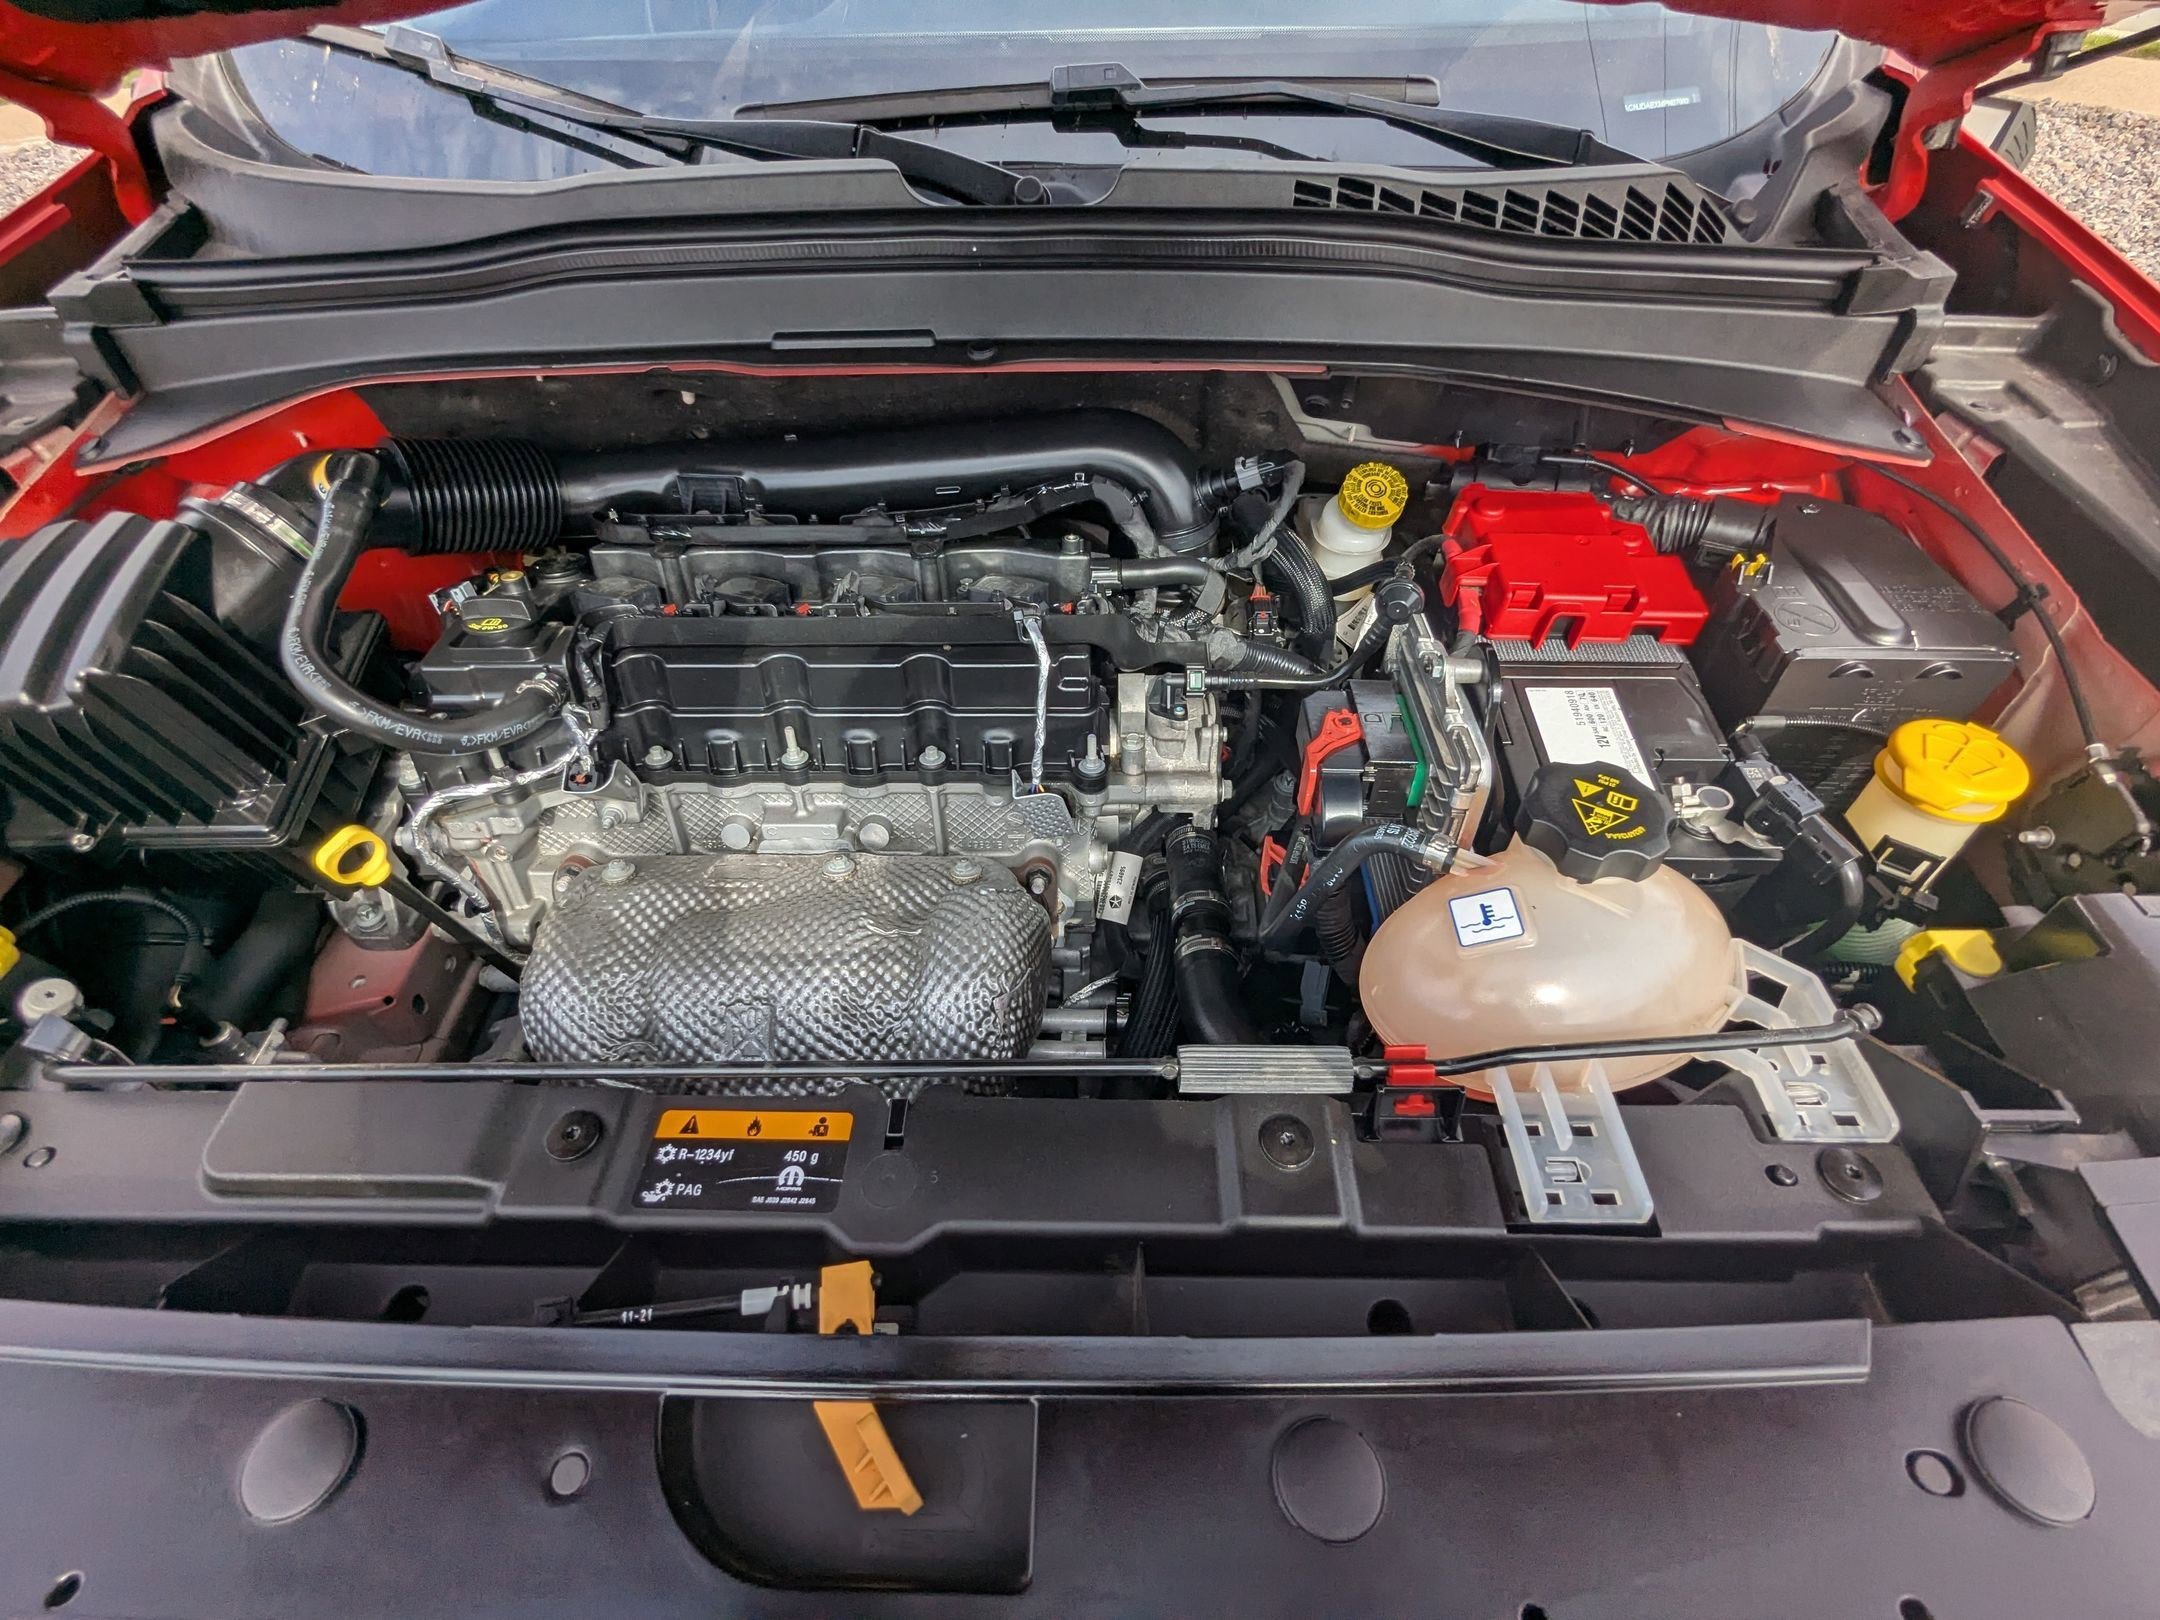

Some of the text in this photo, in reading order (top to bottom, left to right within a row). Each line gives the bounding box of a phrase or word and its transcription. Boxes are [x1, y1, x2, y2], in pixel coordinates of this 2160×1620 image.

[1564, 690, 1586, 726] 51940918
[1594, 735, 1611, 748] 12V
[678, 1147, 820, 1166] R-1234yf 450 g
[675, 1183, 702, 1196] PAG
[621, 1308, 653, 1324] 11-21
